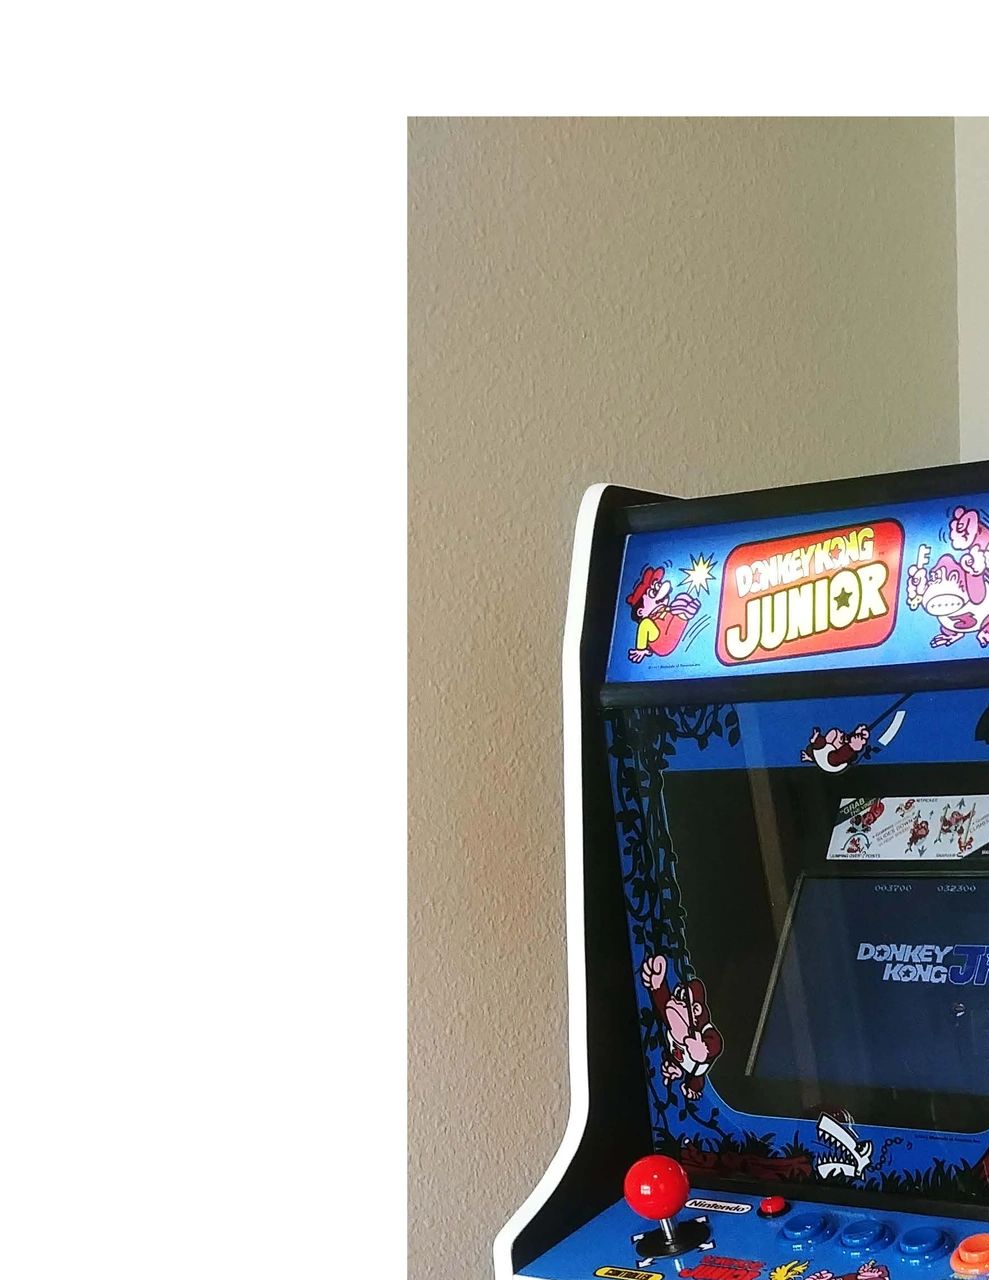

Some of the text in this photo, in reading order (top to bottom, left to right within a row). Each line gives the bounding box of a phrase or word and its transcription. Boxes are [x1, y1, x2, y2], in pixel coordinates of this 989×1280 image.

[735, 527, 875, 598] DONKEY KONG
[725, 560, 890, 661] JUNIOR
[857, 943, 954, 962] DONKEY
[883, 964, 949, 984] KONG
[689, 1200, 746, 1213] Nintendo
